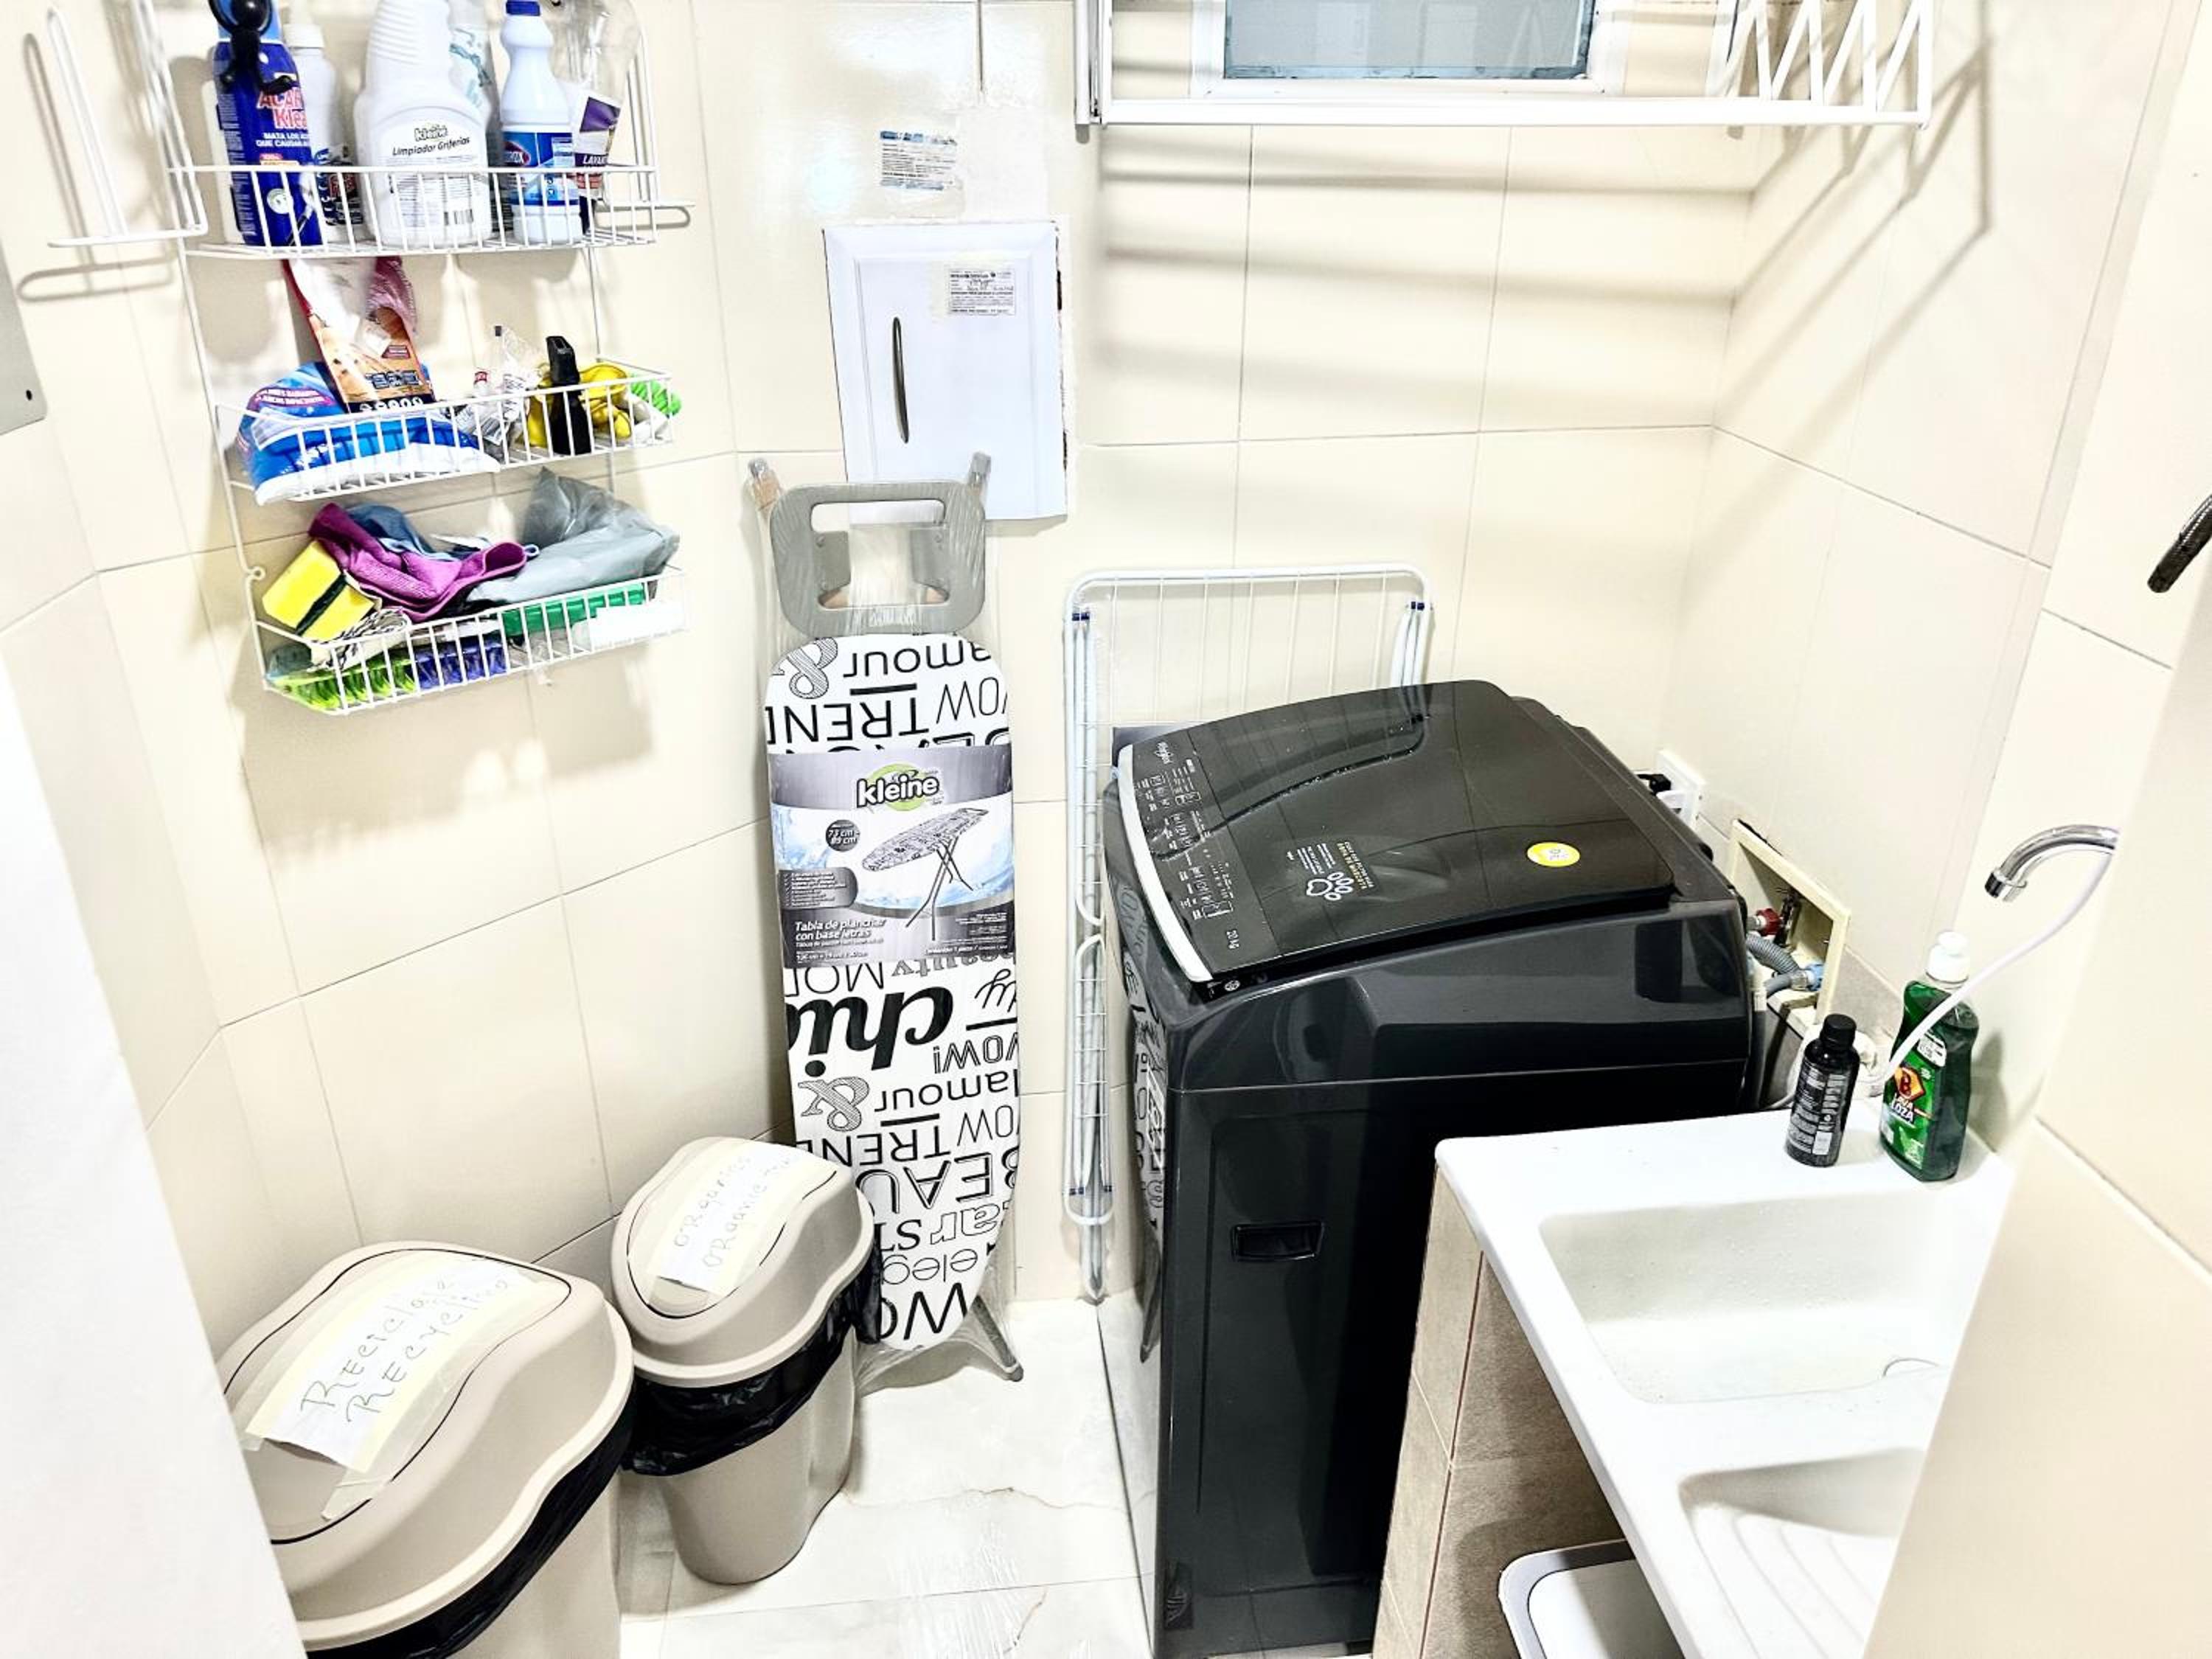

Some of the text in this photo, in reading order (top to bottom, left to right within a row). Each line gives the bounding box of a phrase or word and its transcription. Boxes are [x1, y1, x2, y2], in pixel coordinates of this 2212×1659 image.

[392, 145, 436, 156] Limpiador
[856, 771, 940, 808] kleine
[796, 920, 824, 931] Tabla
[825, 919, 839, 930] de
[796, 932, 814, 942] con
[815, 930, 841, 940] base
